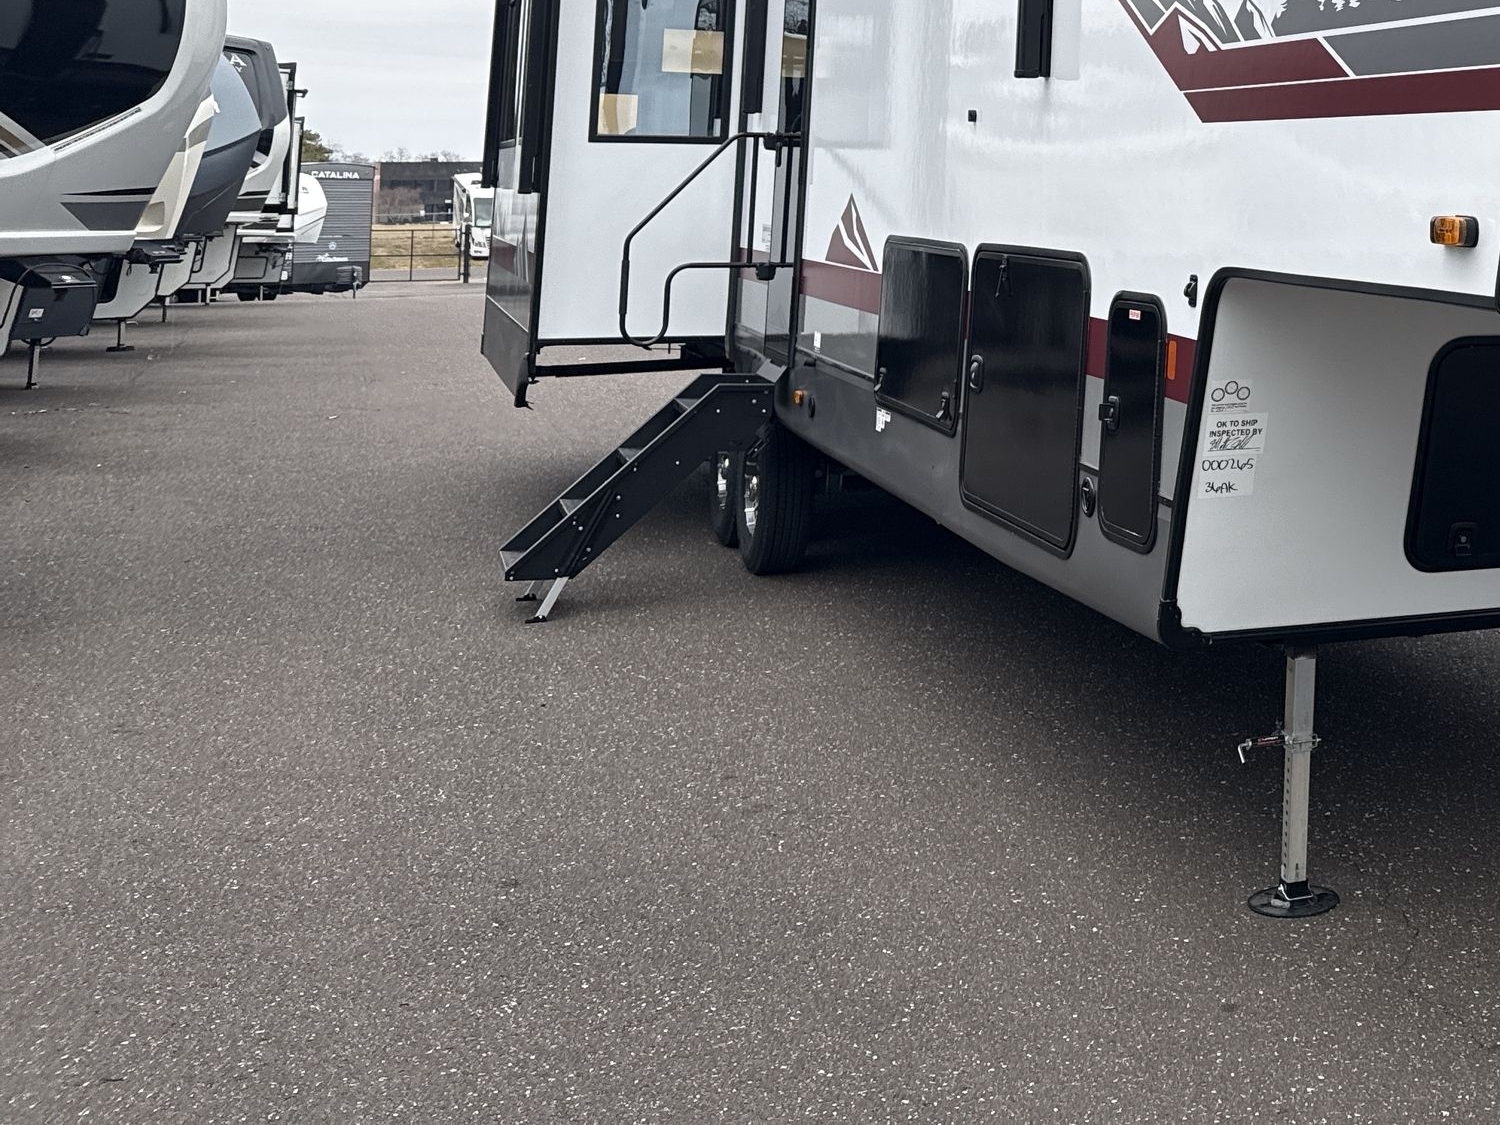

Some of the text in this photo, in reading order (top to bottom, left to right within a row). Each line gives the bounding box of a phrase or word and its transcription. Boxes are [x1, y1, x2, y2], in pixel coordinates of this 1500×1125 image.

[311, 170, 360, 179] CATALINA
[1216, 420, 1228, 428] OK
[1240, 419, 1258, 427] SHIP
[1209, 428, 1263, 438] INSPECTED BY
[1202, 457, 1255, 472] 000265
